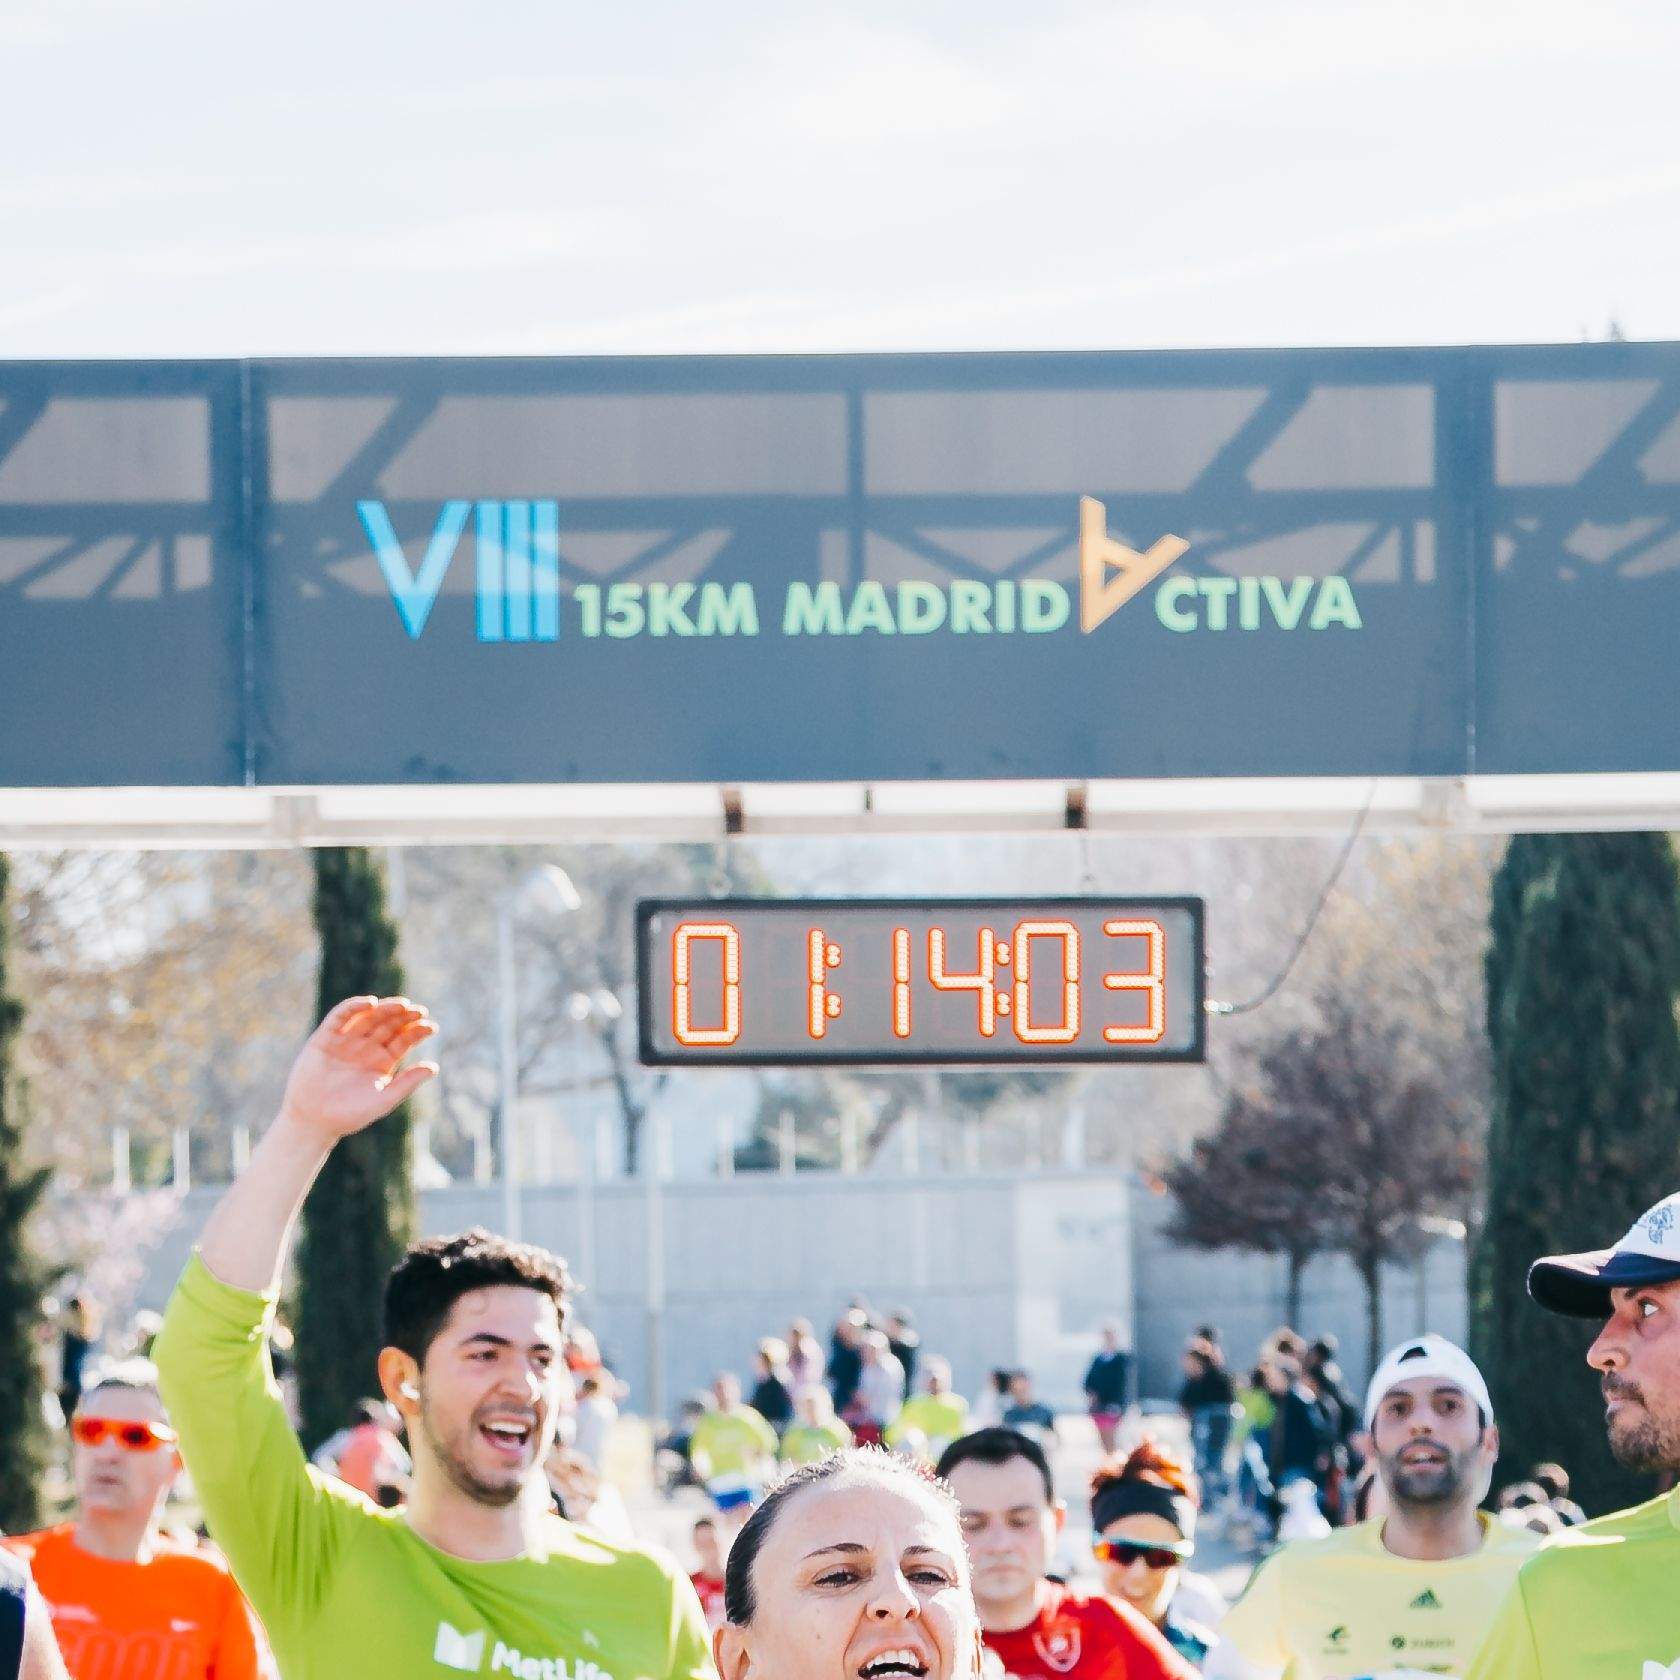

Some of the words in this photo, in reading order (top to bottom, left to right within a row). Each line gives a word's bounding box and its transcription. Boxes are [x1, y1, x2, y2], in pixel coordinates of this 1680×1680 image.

[356, 500, 559, 642] VIII
[573, 582, 760, 639] 15KM
[782, 580, 1070, 637] MADRID
